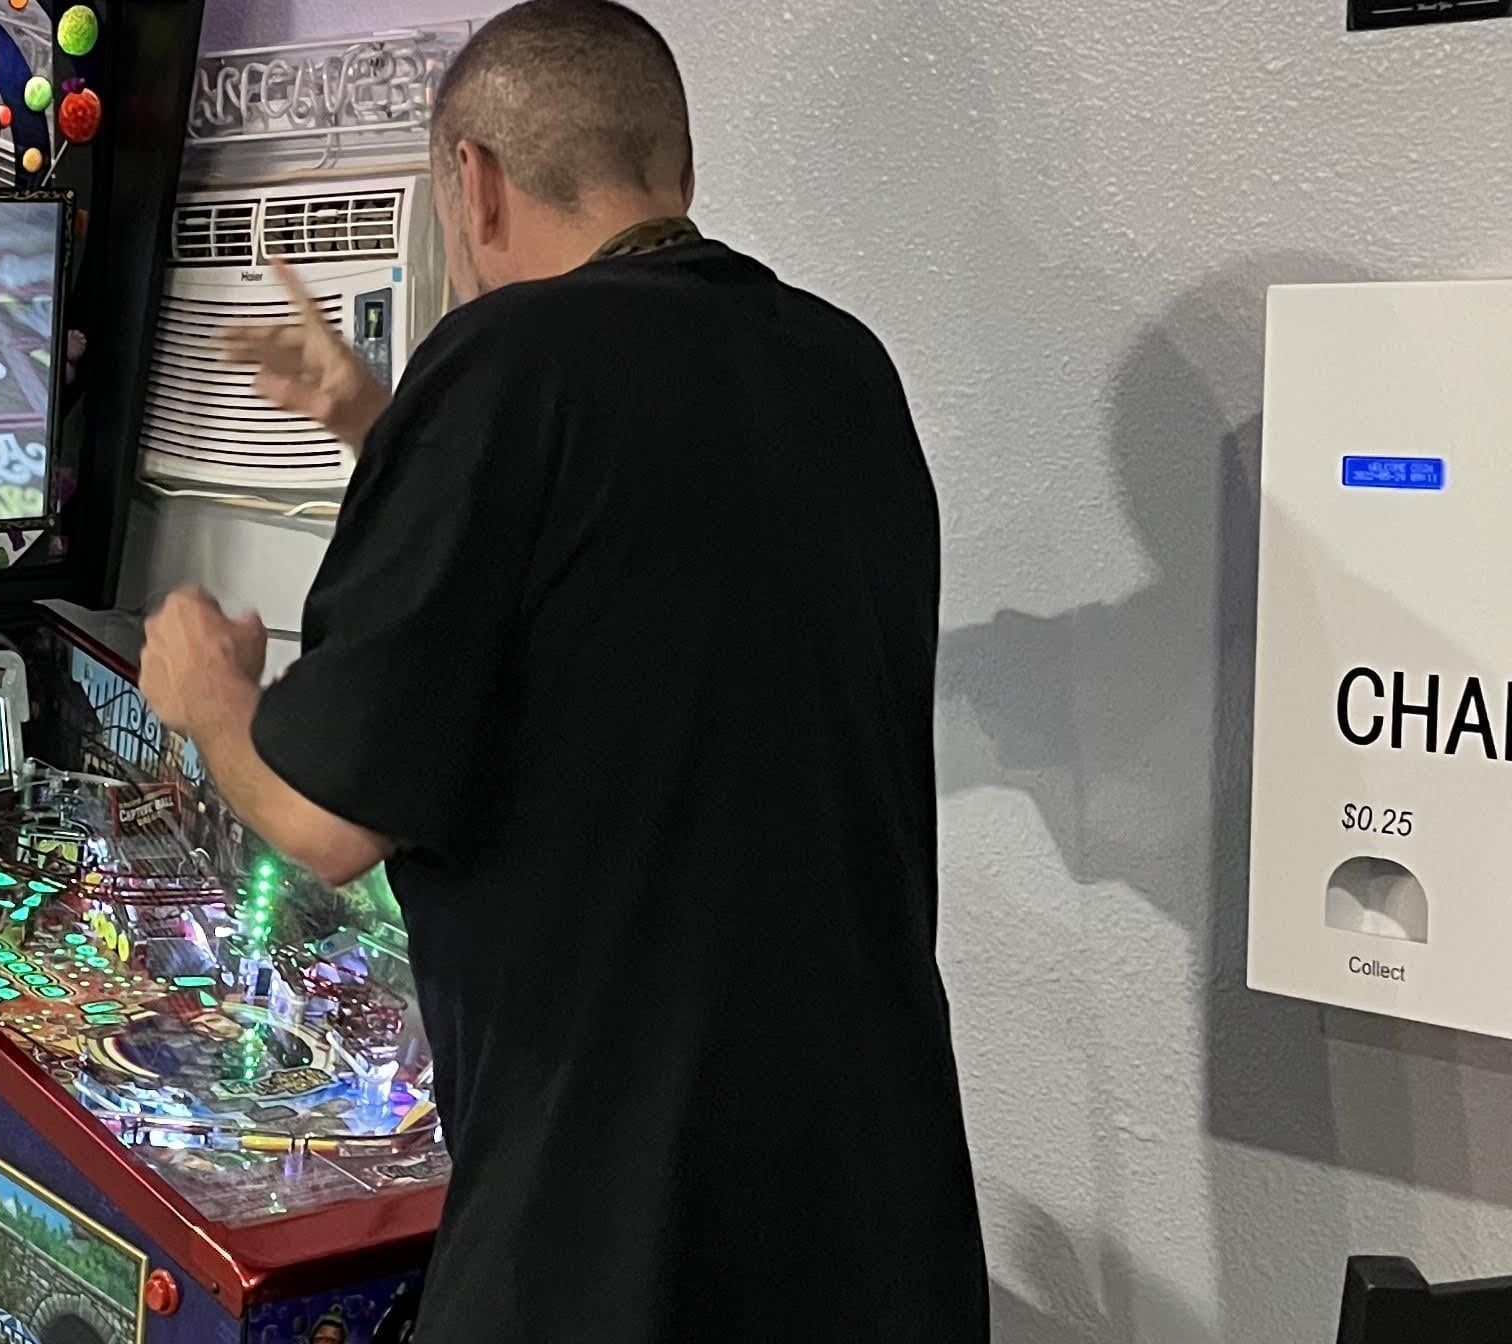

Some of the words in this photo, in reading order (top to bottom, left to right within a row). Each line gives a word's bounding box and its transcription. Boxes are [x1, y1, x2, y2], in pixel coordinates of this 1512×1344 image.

[241, 271, 263, 282] Haier
[1341, 803, 1414, 838] $0.25
[1348, 956, 1406, 983] Collect
